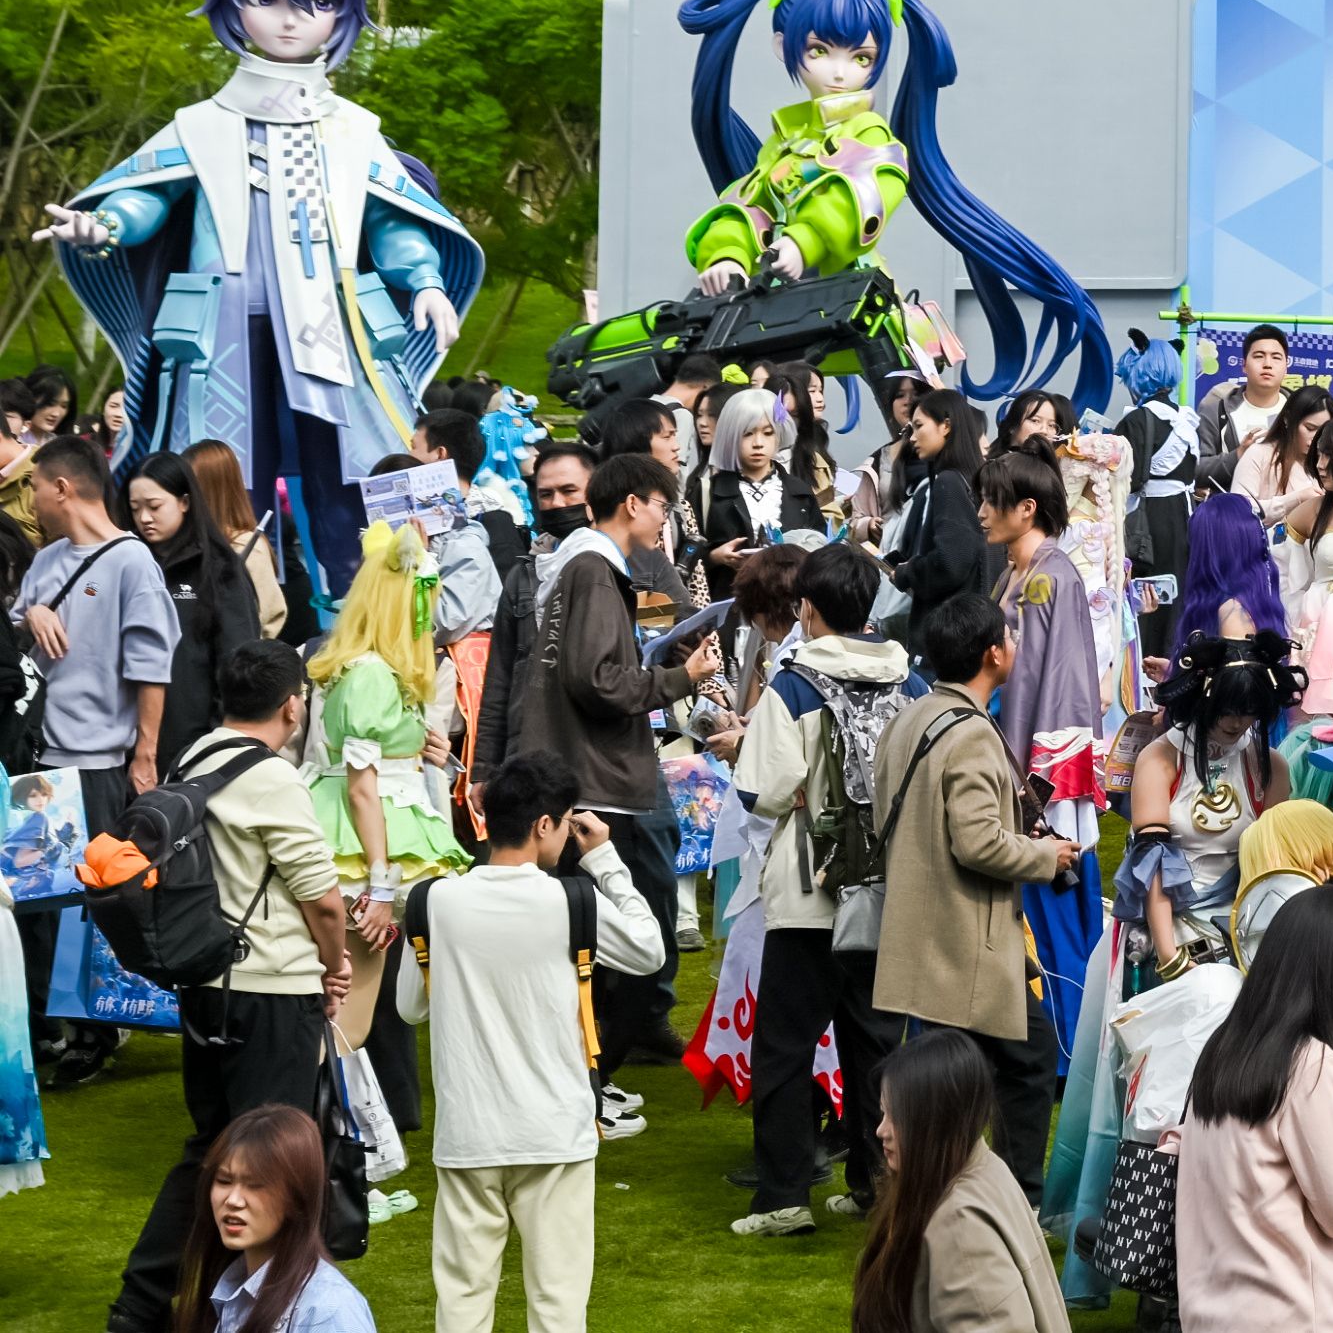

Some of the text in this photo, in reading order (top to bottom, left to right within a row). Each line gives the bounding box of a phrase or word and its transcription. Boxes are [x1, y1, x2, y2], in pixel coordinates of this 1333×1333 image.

[1137, 1149, 1154, 1161] NY
[1120, 1156, 1135, 1168] NY
[1150, 1163, 1167, 1175] NY
[1132, 1170, 1149, 1183] NY
[1115, 1178, 1130, 1190] NY
[1145, 1185, 1162, 1198] NY
[1127, 1192, 1144, 1204] NY
[1111, 1199, 1125, 1212] NY
[1158, 1200, 1173, 1212] NY
[1139, 1207, 1157, 1219] NY
[1121, 1214, 1139, 1226] NY
[1107, 1222, 1121, 1234] NY
[1152, 1222, 1169, 1234] NY
[1134, 1229, 1151, 1241] NY
[1116, 1236, 1133, 1249] NY
[1147, 1243, 1163, 1255] NY
[1128, 1251, 1146, 1263] NY
[1111, 1258, 1127, 1270] NY
[1158, 1258, 1173, 1269] NY
[1140, 1266, 1156, 1277] NY
[1121, 1273, 1138, 1284] NY
[1150, 1279, 1166, 1289] NY
